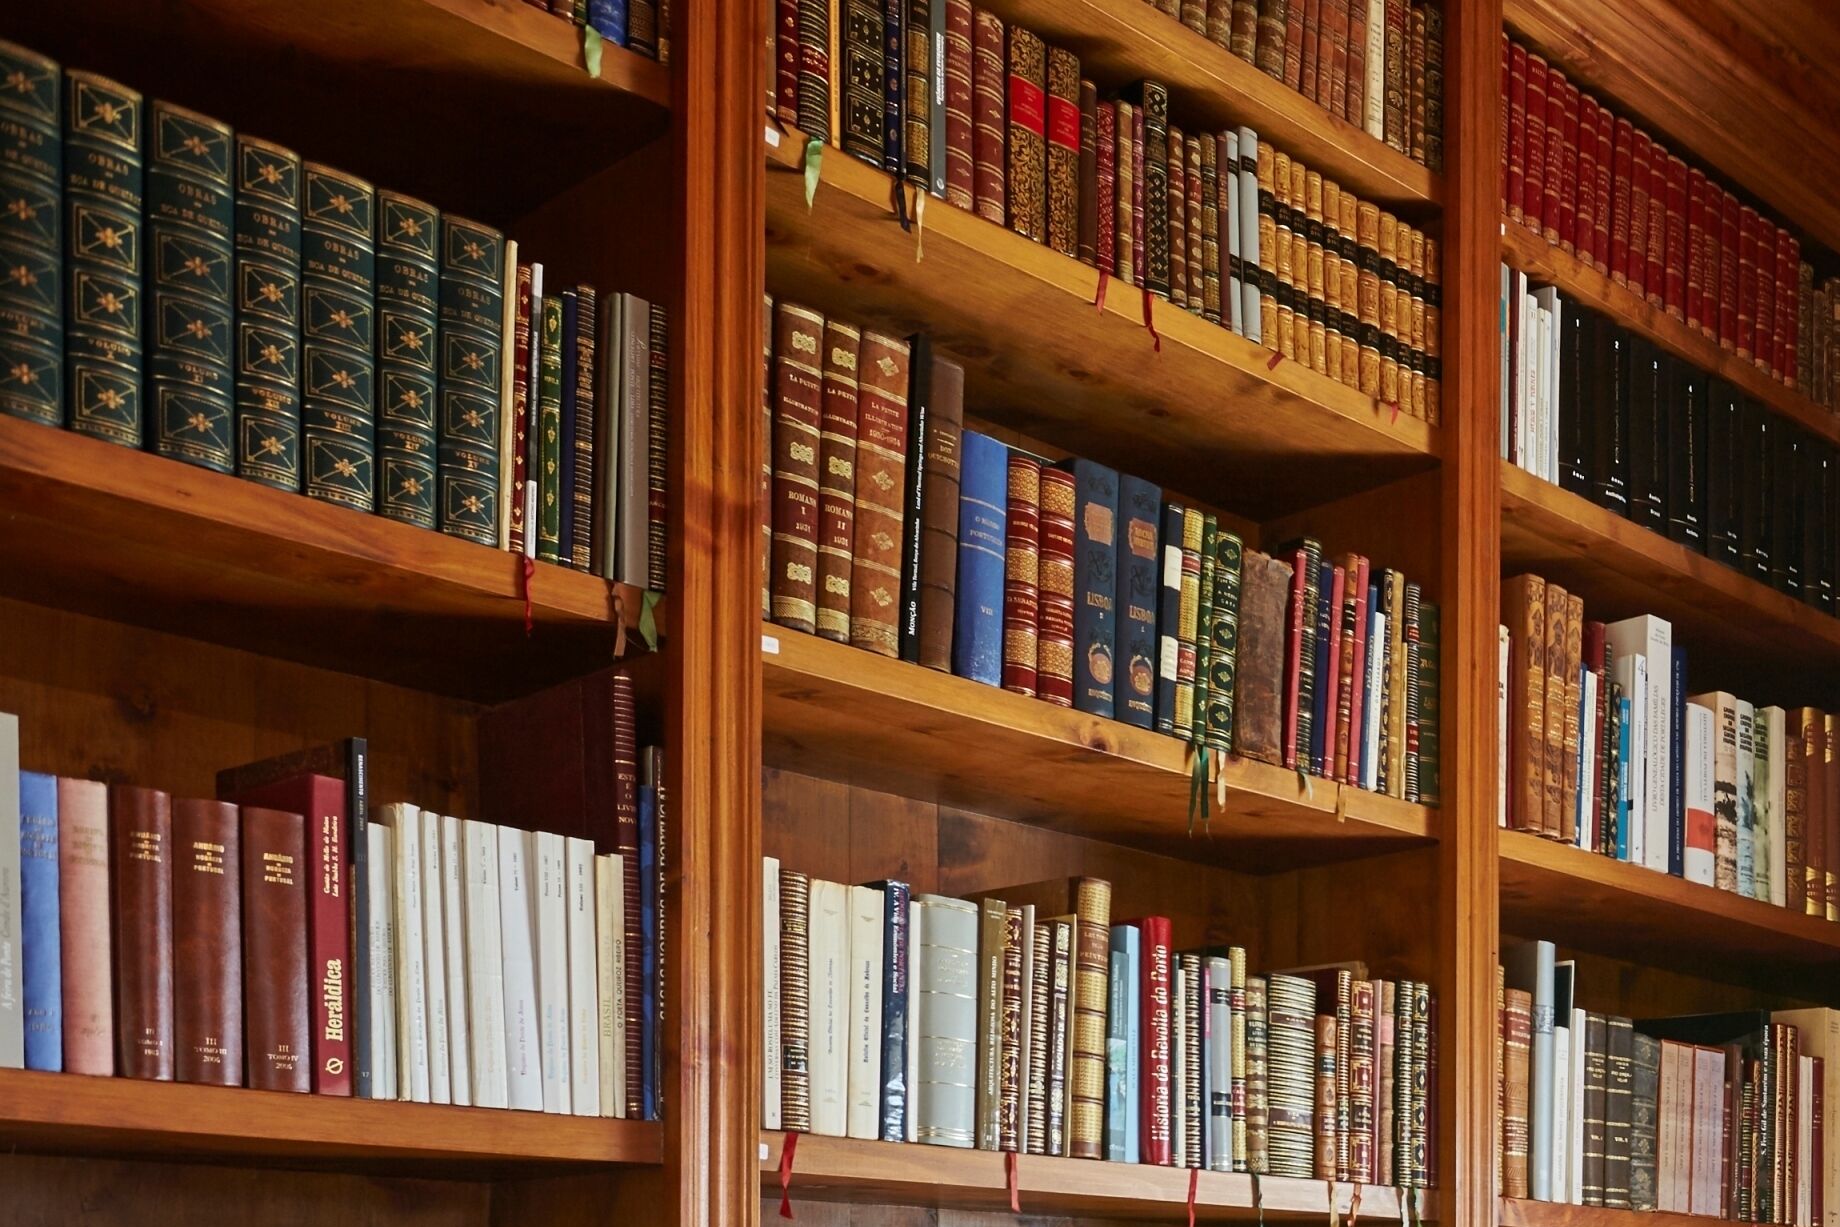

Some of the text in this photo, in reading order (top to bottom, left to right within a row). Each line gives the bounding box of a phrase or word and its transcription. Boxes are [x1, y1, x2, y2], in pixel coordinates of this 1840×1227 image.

[88, 152, 129, 176] OBRAS
[178, 183, 217, 205] OBRAS
[88, 337, 132, 357] VOLUME
[1086, 591, 1112, 610] LISBOA
[1150, 945, 1167, 982] Porto
[323, 958, 345, 1043] Heráldica
[1150, 987, 1168, 1005] do
[1150, 1009, 1169, 1060] Revolta
[1762, 1024, 1770, 1046] época
[1152, 1064, 1169, 1081] da
